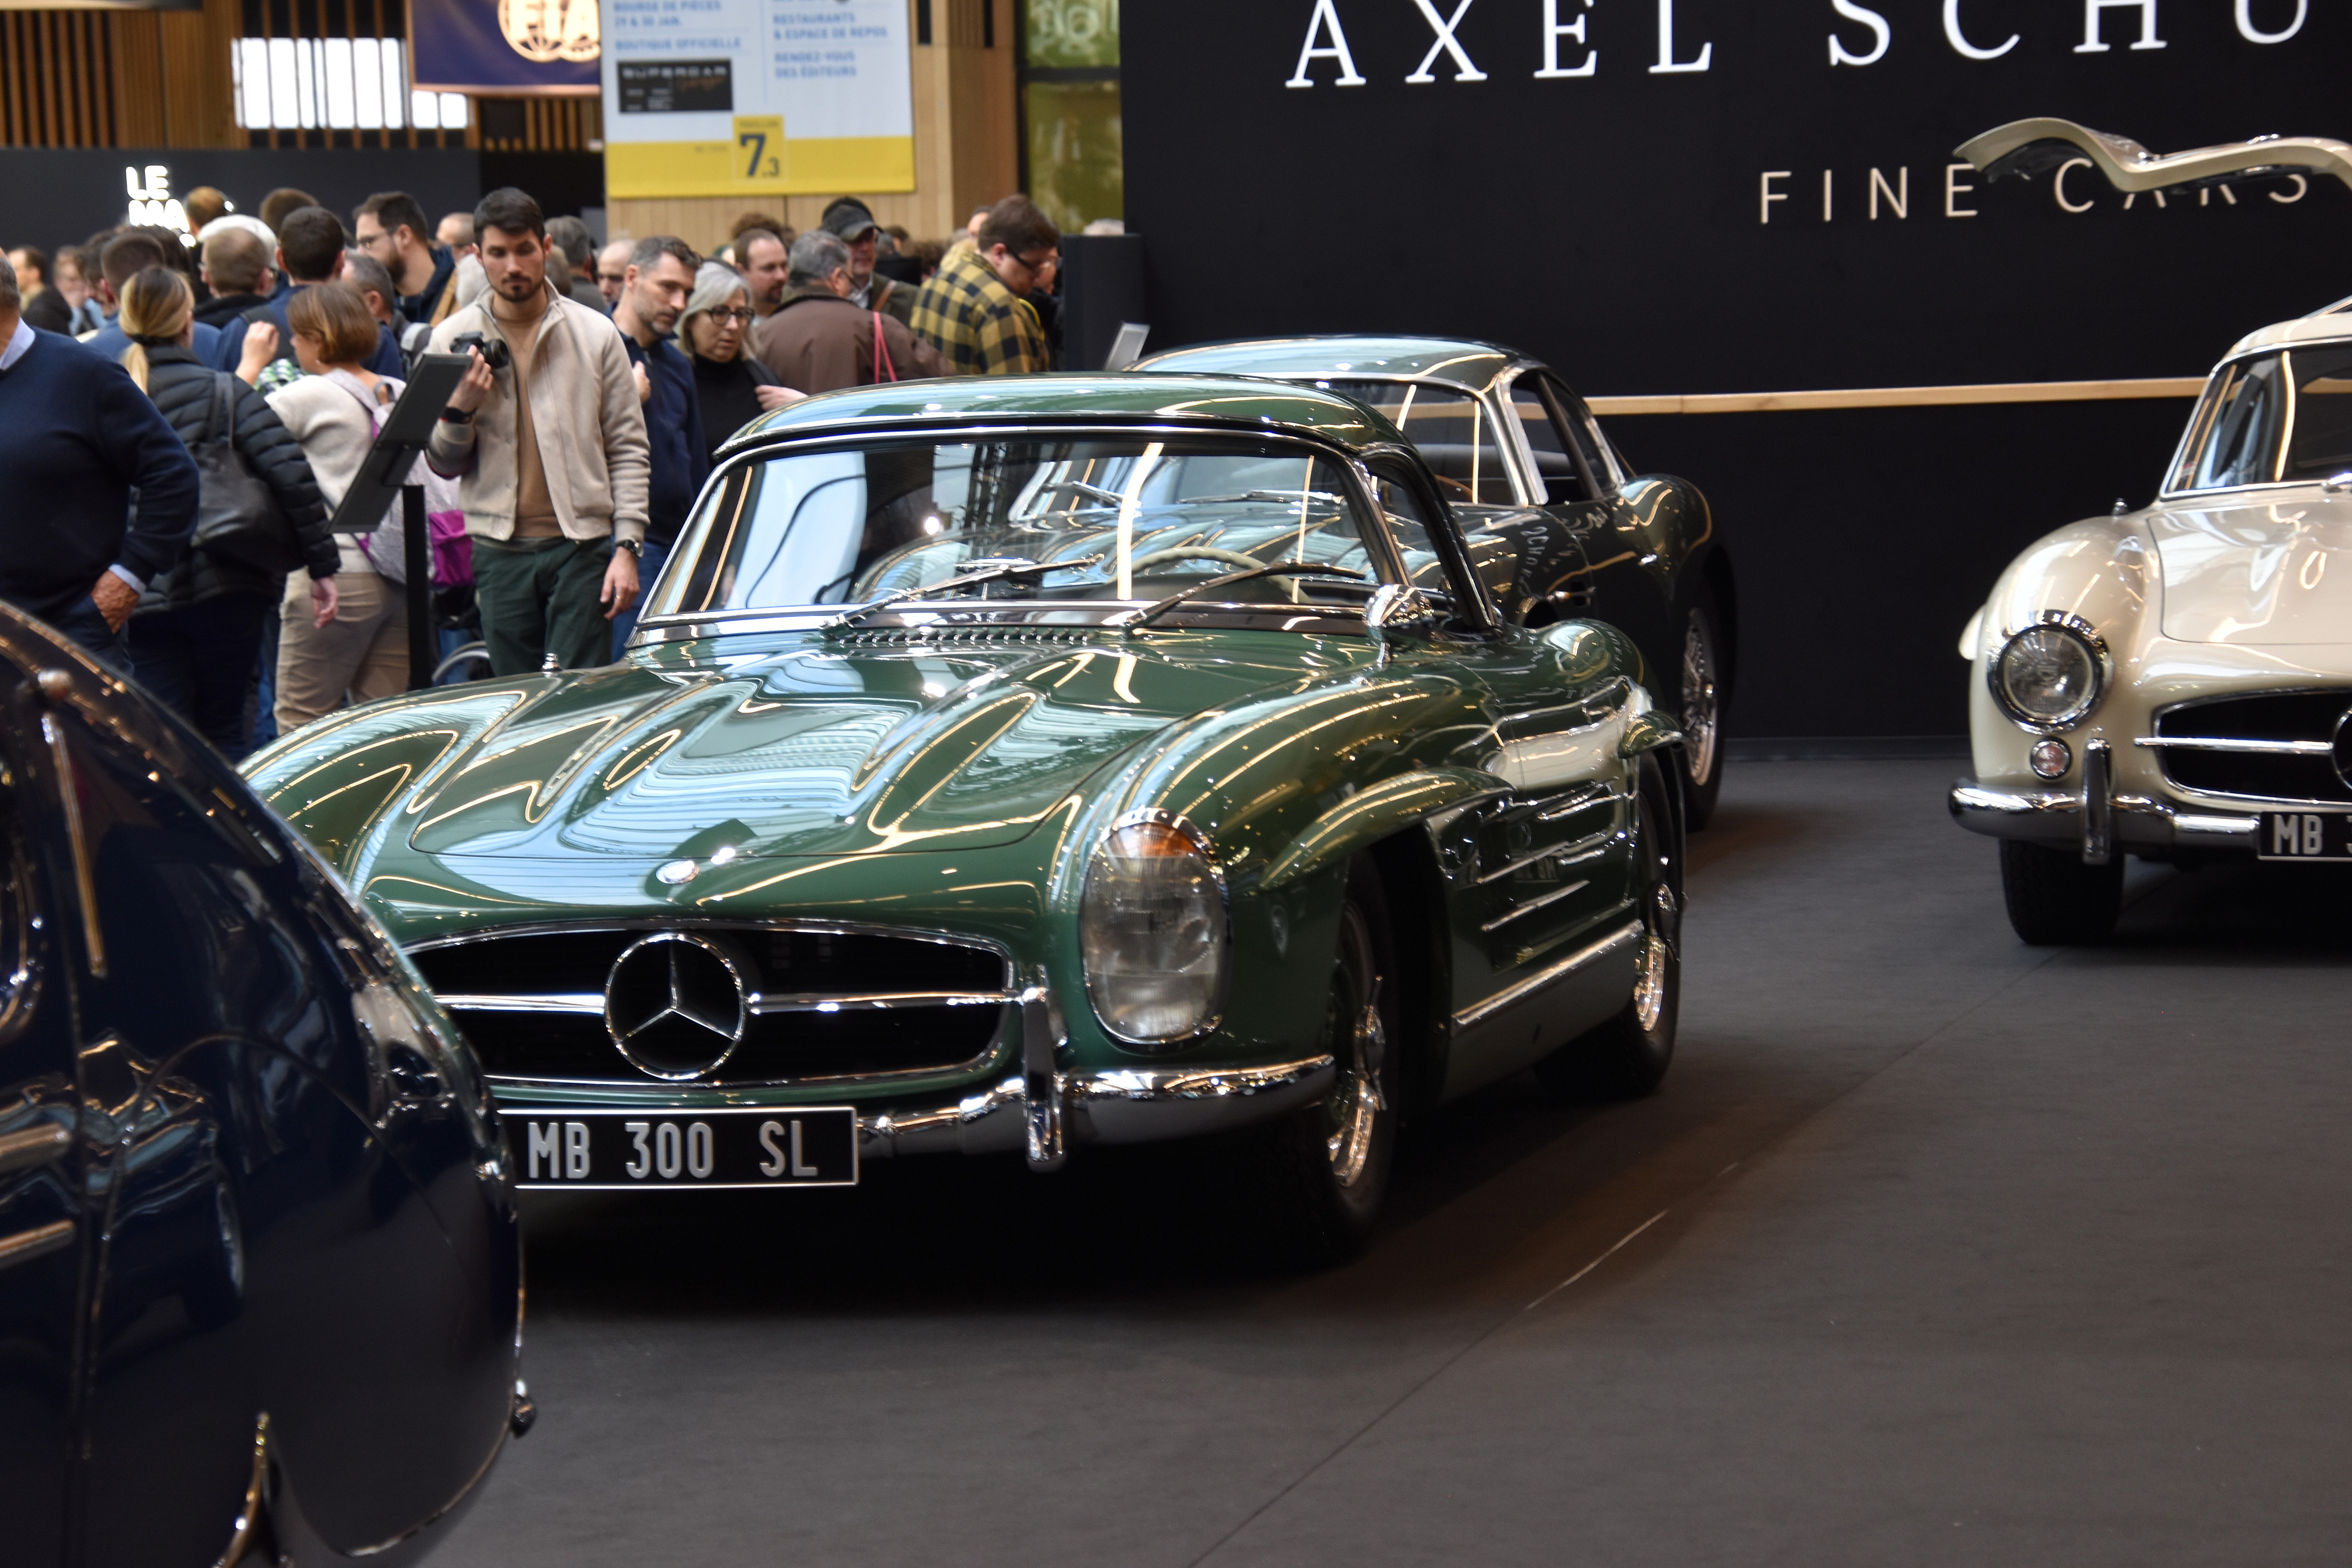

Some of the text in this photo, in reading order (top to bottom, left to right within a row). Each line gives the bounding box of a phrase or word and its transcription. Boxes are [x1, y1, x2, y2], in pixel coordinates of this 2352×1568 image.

[1285, 0, 1712, 88] AXEL
[125, 165, 170, 201] LE
[1761, 164, 1978, 224] FINE
[2273, 814, 2323, 855] MB
[528, 1120, 818, 1179] MB 300 SL
